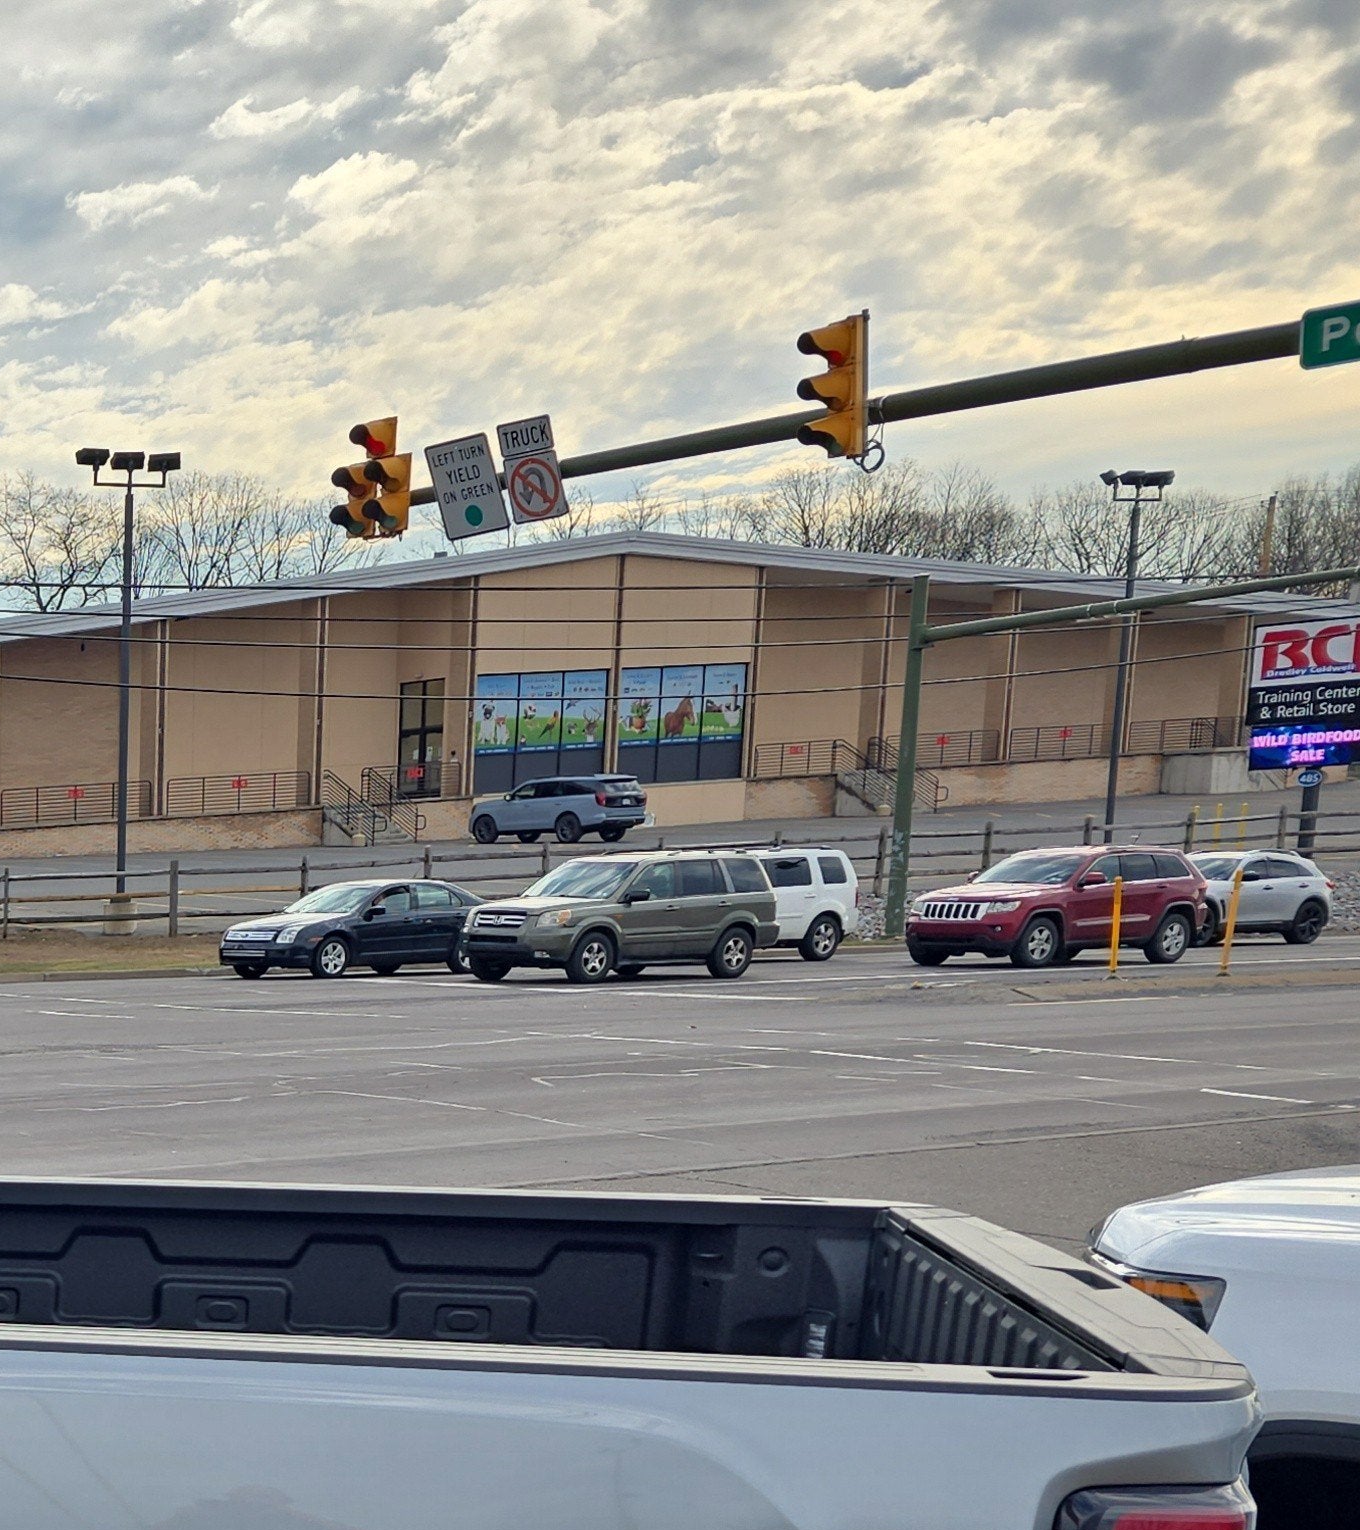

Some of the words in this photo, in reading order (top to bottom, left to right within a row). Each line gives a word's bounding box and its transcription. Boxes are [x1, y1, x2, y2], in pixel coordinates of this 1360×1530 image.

[1322, 316, 1360, 352] P
[502, 423, 549, 450] TRUCK
[431, 451, 455, 468] LEFT
[458, 444, 485, 461] TURN
[446, 464, 481, 485] YIELD
[443, 491, 458, 505] ON
[461, 482, 495, 501] GREEN
[1257, 690, 1311, 704] Training
[1316, 685, 1360, 700] Center
[1260, 706, 1272, 719] &
[1277, 702, 1314, 718] Retail
[1318, 702, 1356, 715] Store
[1253, 734, 1288, 748] WILD
[1291, 729, 1360, 746] BIRDFOOD
[1290, 749, 1325, 763] SALE
[1299, 773, 1319, 784] 485
